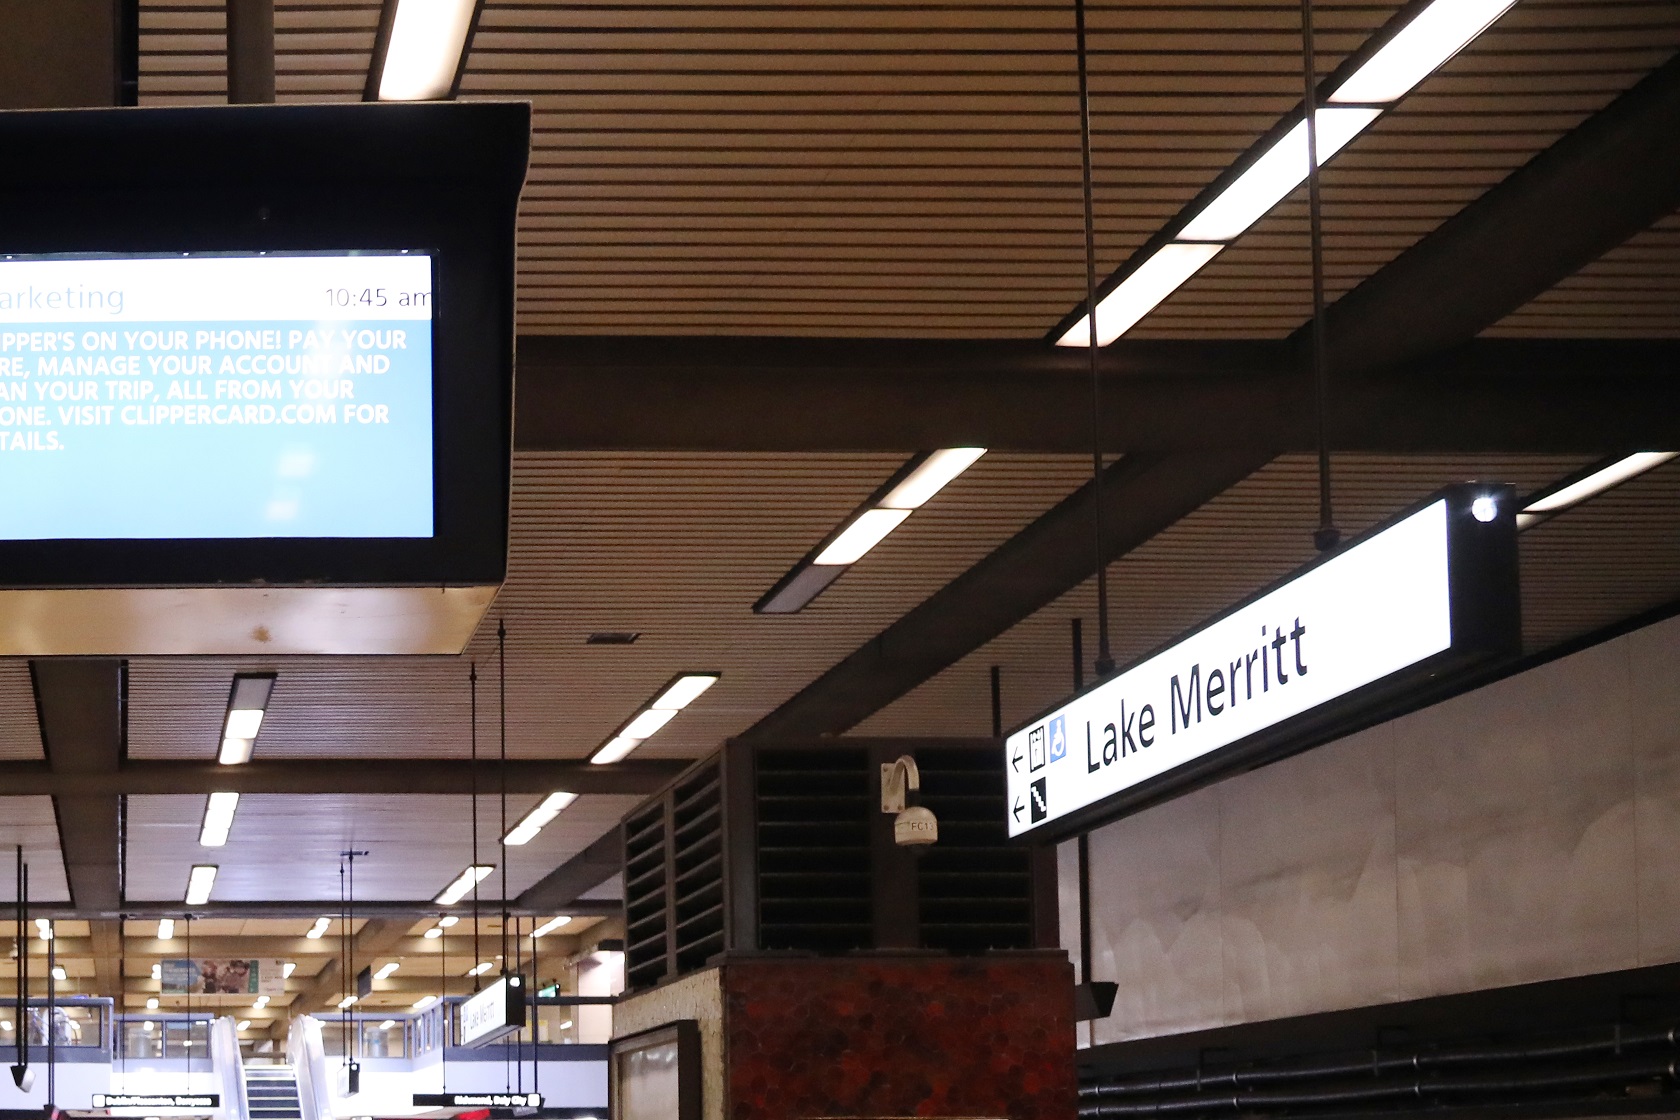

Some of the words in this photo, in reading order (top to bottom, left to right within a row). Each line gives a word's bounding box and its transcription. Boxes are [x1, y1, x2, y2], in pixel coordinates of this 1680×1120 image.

[326, 288, 387, 307] 10:45
[82, 331, 117, 351] ON
[124, 330, 188, 350] YOUR
[196, 329, 281, 350] PHONE!
[289, 329, 335, 350] PAY
[341, 329, 407, 349] YOUR
[38, 355, 140, 376] MANAGE
[147, 354, 212, 375] YOUR
[219, 354, 333, 375] ACCOUNT
[339, 354, 390, 374] AND
[34, 380, 99, 401] YOUR
[105, 379, 160, 403] TRIP,
[166, 379, 208, 400] ALL
[215, 379, 282, 400] FROM
[289, 378, 355, 399] YOUR
[58, 404, 115, 425] VISIT
[121, 403, 336, 425] CLIPPERCARD.COM
[344, 402, 390, 424] FOR
[1086, 699, 1155, 774] Lake
[1170, 616, 1308, 735] Merritt
